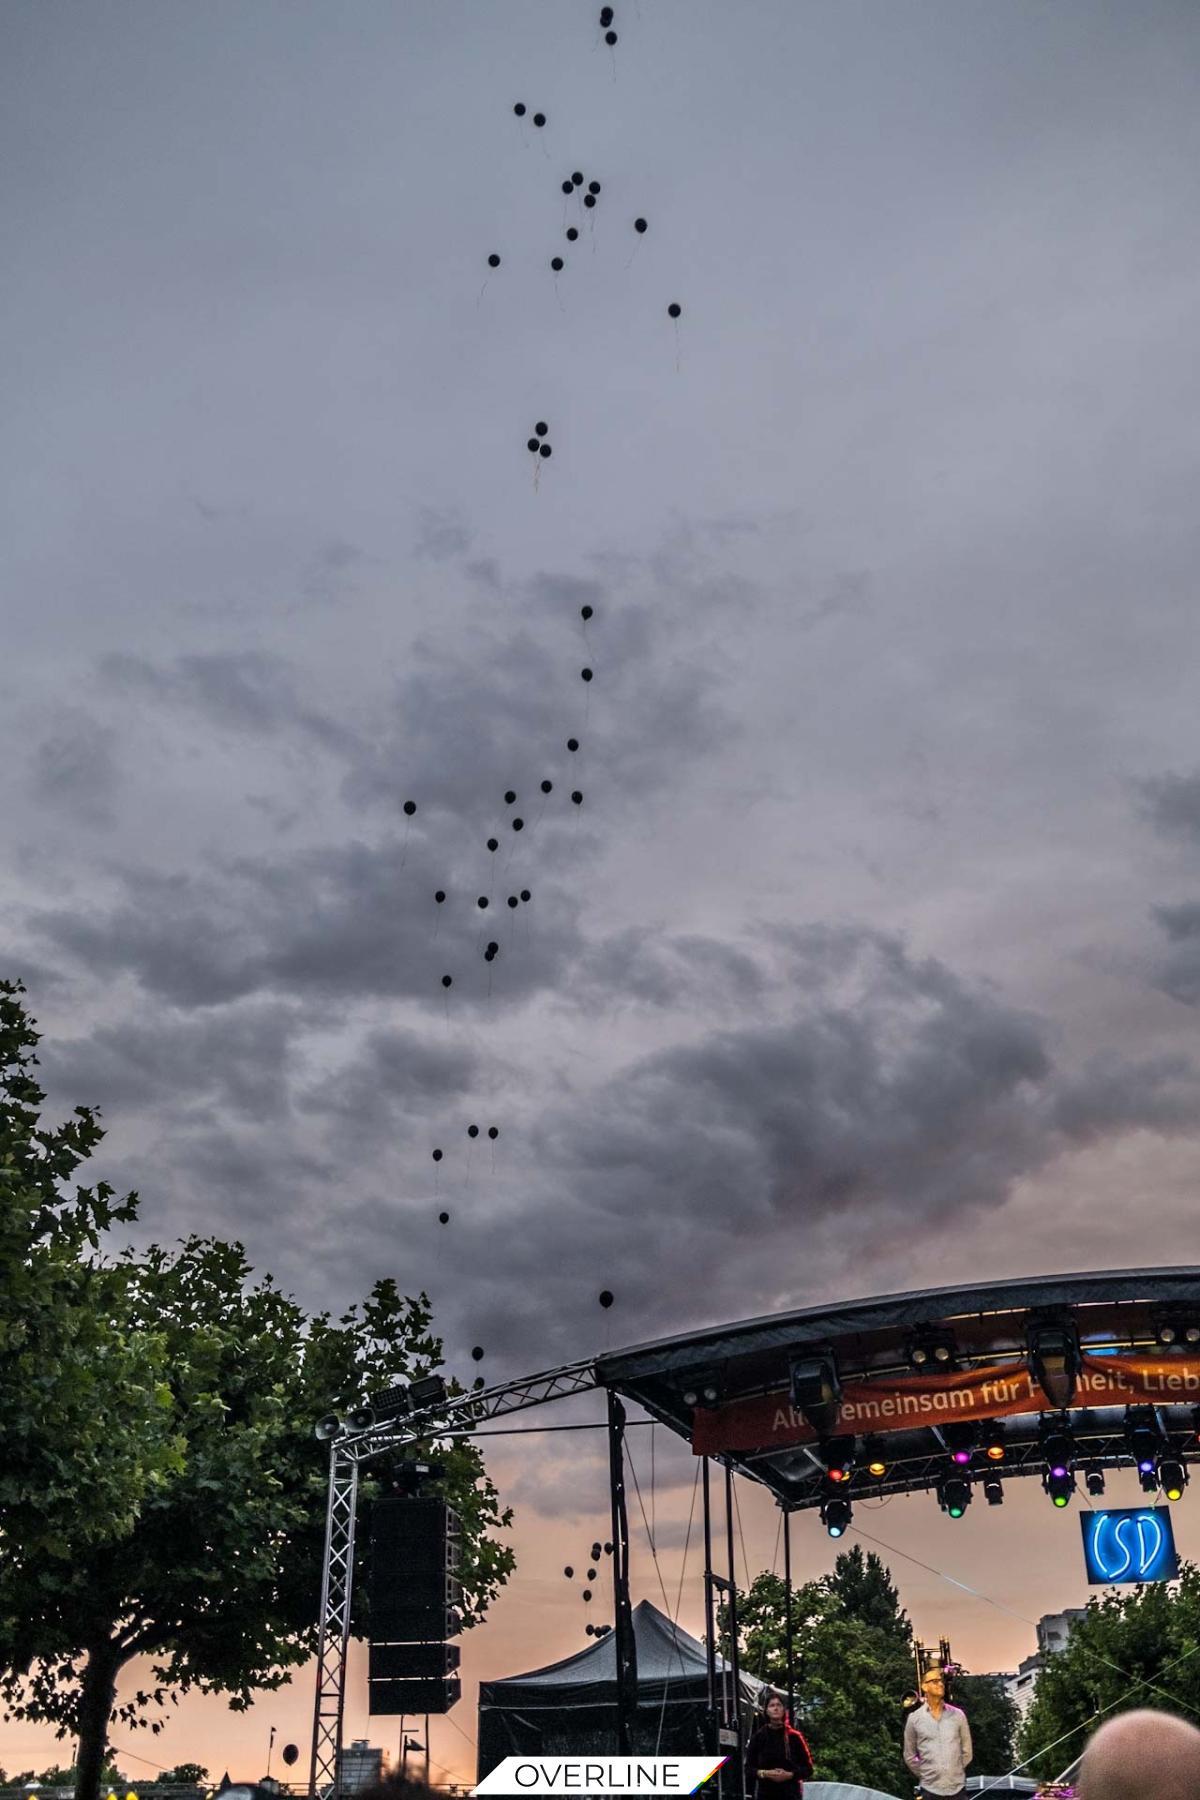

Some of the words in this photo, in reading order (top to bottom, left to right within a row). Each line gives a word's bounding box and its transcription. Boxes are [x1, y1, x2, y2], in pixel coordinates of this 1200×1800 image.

[772, 1405, 811, 1431] All
[834, 1387, 975, 1425] emeinsam
[980, 1380, 1019, 1404] für
[1026, 1369, 1134, 1398] Fheit,
